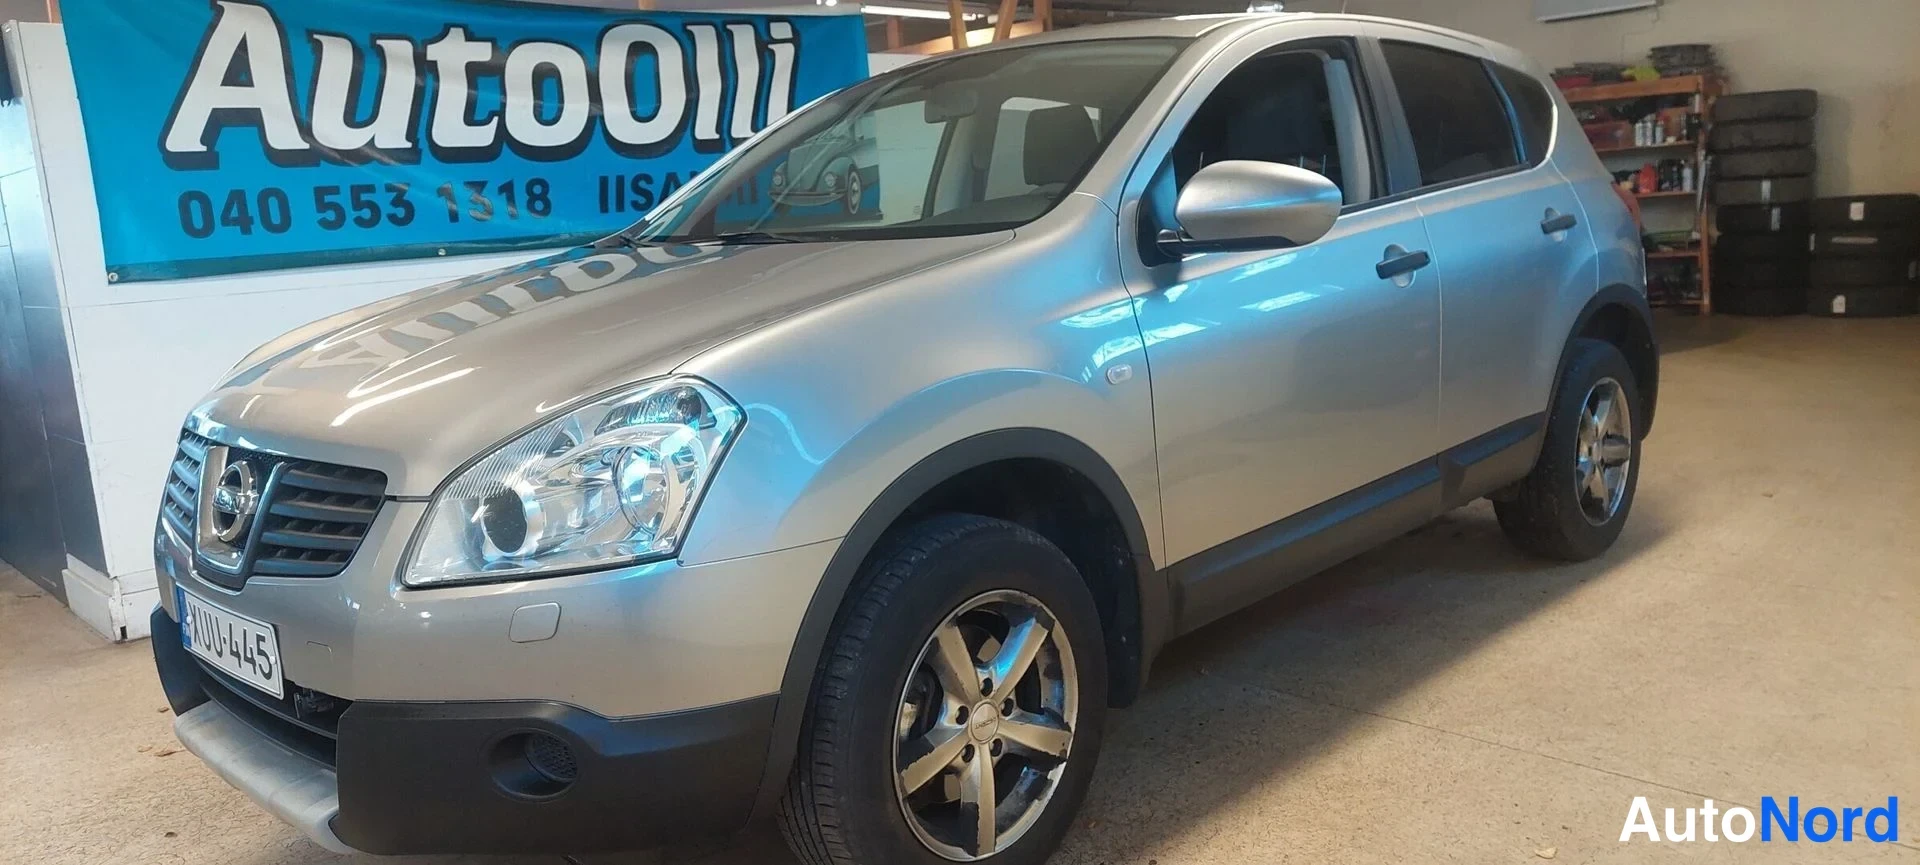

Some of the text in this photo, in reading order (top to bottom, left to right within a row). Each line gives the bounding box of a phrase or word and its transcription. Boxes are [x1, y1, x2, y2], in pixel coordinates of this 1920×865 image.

[160, 0, 797, 168] AutoOlli
[178, 187, 292, 239] 040
[313, 182, 415, 231] 553
[436, 177, 552, 223] 1318
[188, 601, 273, 681] XUU-445
